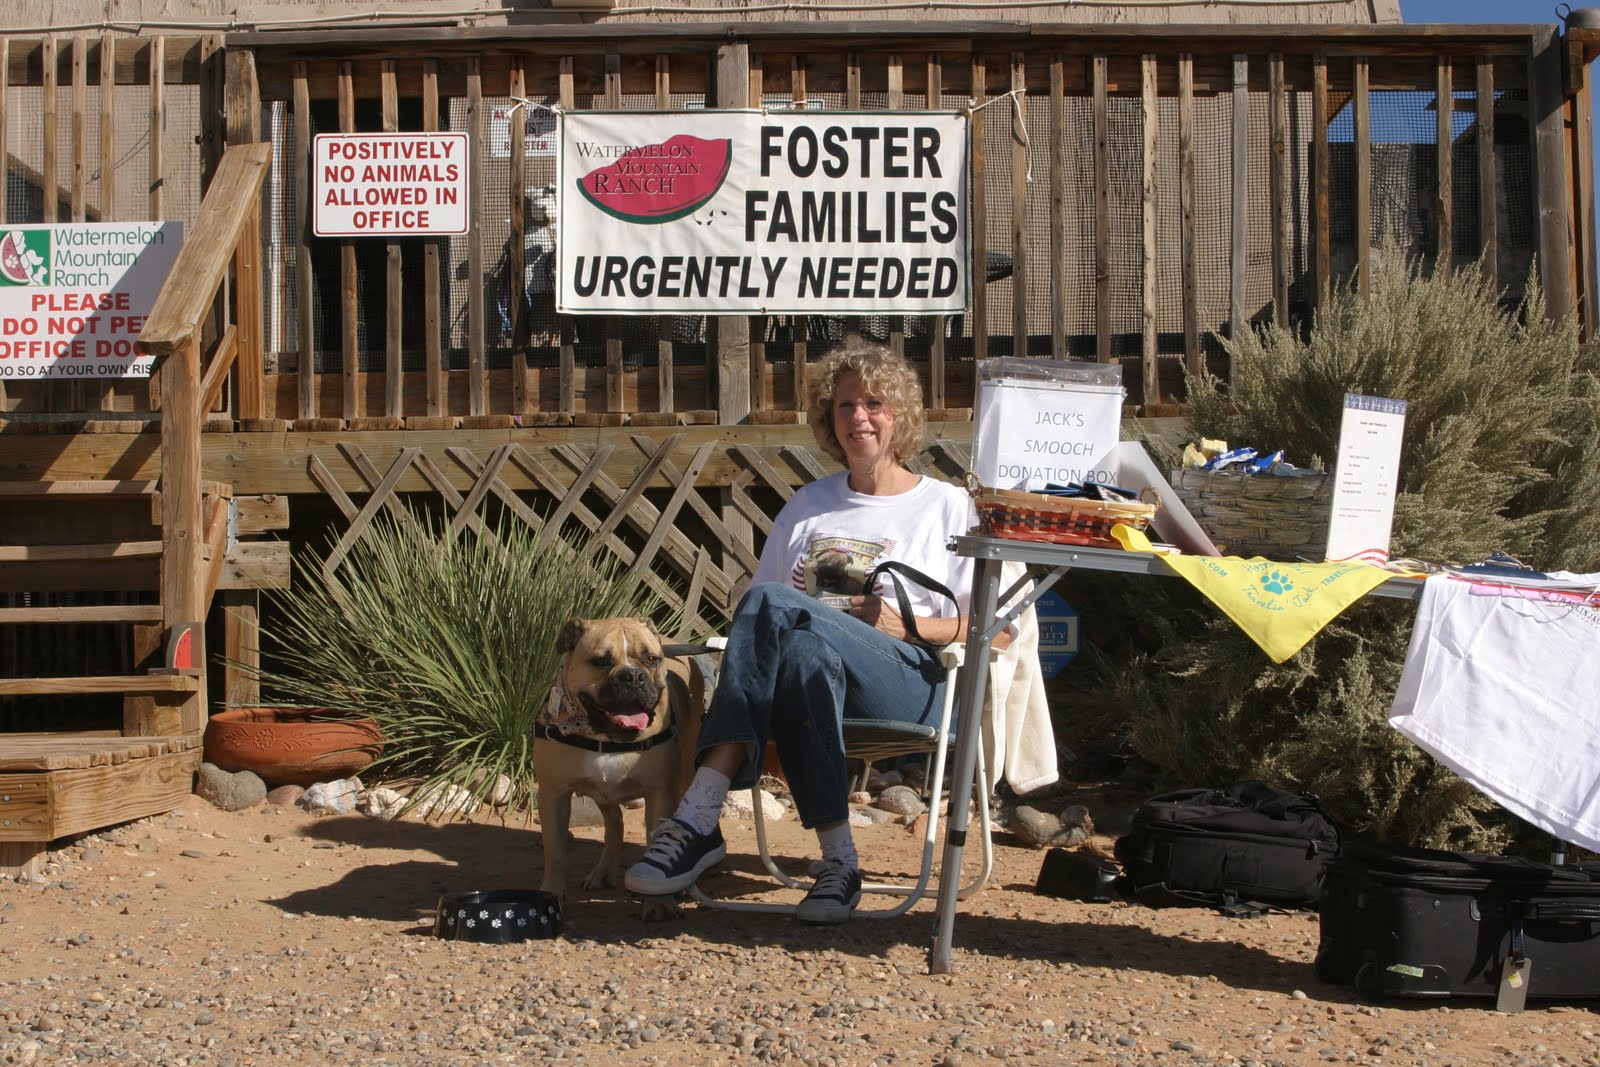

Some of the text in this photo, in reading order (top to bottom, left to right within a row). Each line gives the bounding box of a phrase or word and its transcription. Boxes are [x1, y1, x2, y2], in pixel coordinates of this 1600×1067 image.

[328, 141, 455, 160] POSITIVELY
[504, 141, 548, 151] RSTER
[575, 141, 694, 159] WATERMELON
[760, 125, 943, 179] FOSTER
[324, 164, 459, 183] NO ANIMALS
[614, 160, 701, 176] MOUNTAIN
[593, 173, 675, 195] RANCH
[324, 187, 457, 206] ALLOWED IN
[352, 210, 430, 229] OFFICE
[745, 190, 958, 244] FAMILIES
[55, 226, 164, 246] Watermelon
[54, 249, 137, 267] Mountain
[54, 268, 109, 287] Ranch
[573, 255, 959, 298] URGENTLY NEEDED
[32, 293, 130, 311] PLEASE
[3, 317, 39, 335] DO
[48, 317, 102, 335] NOT
[0, 340, 86, 359] OFFICE
[0, 364, 150, 376] O SO AT YOUR OWN RIS
[1035, 411, 1085, 427] JACK'S
[1024, 439, 1094, 457] SMOOCH
[998, 465, 1117, 485] DONATION BOX
